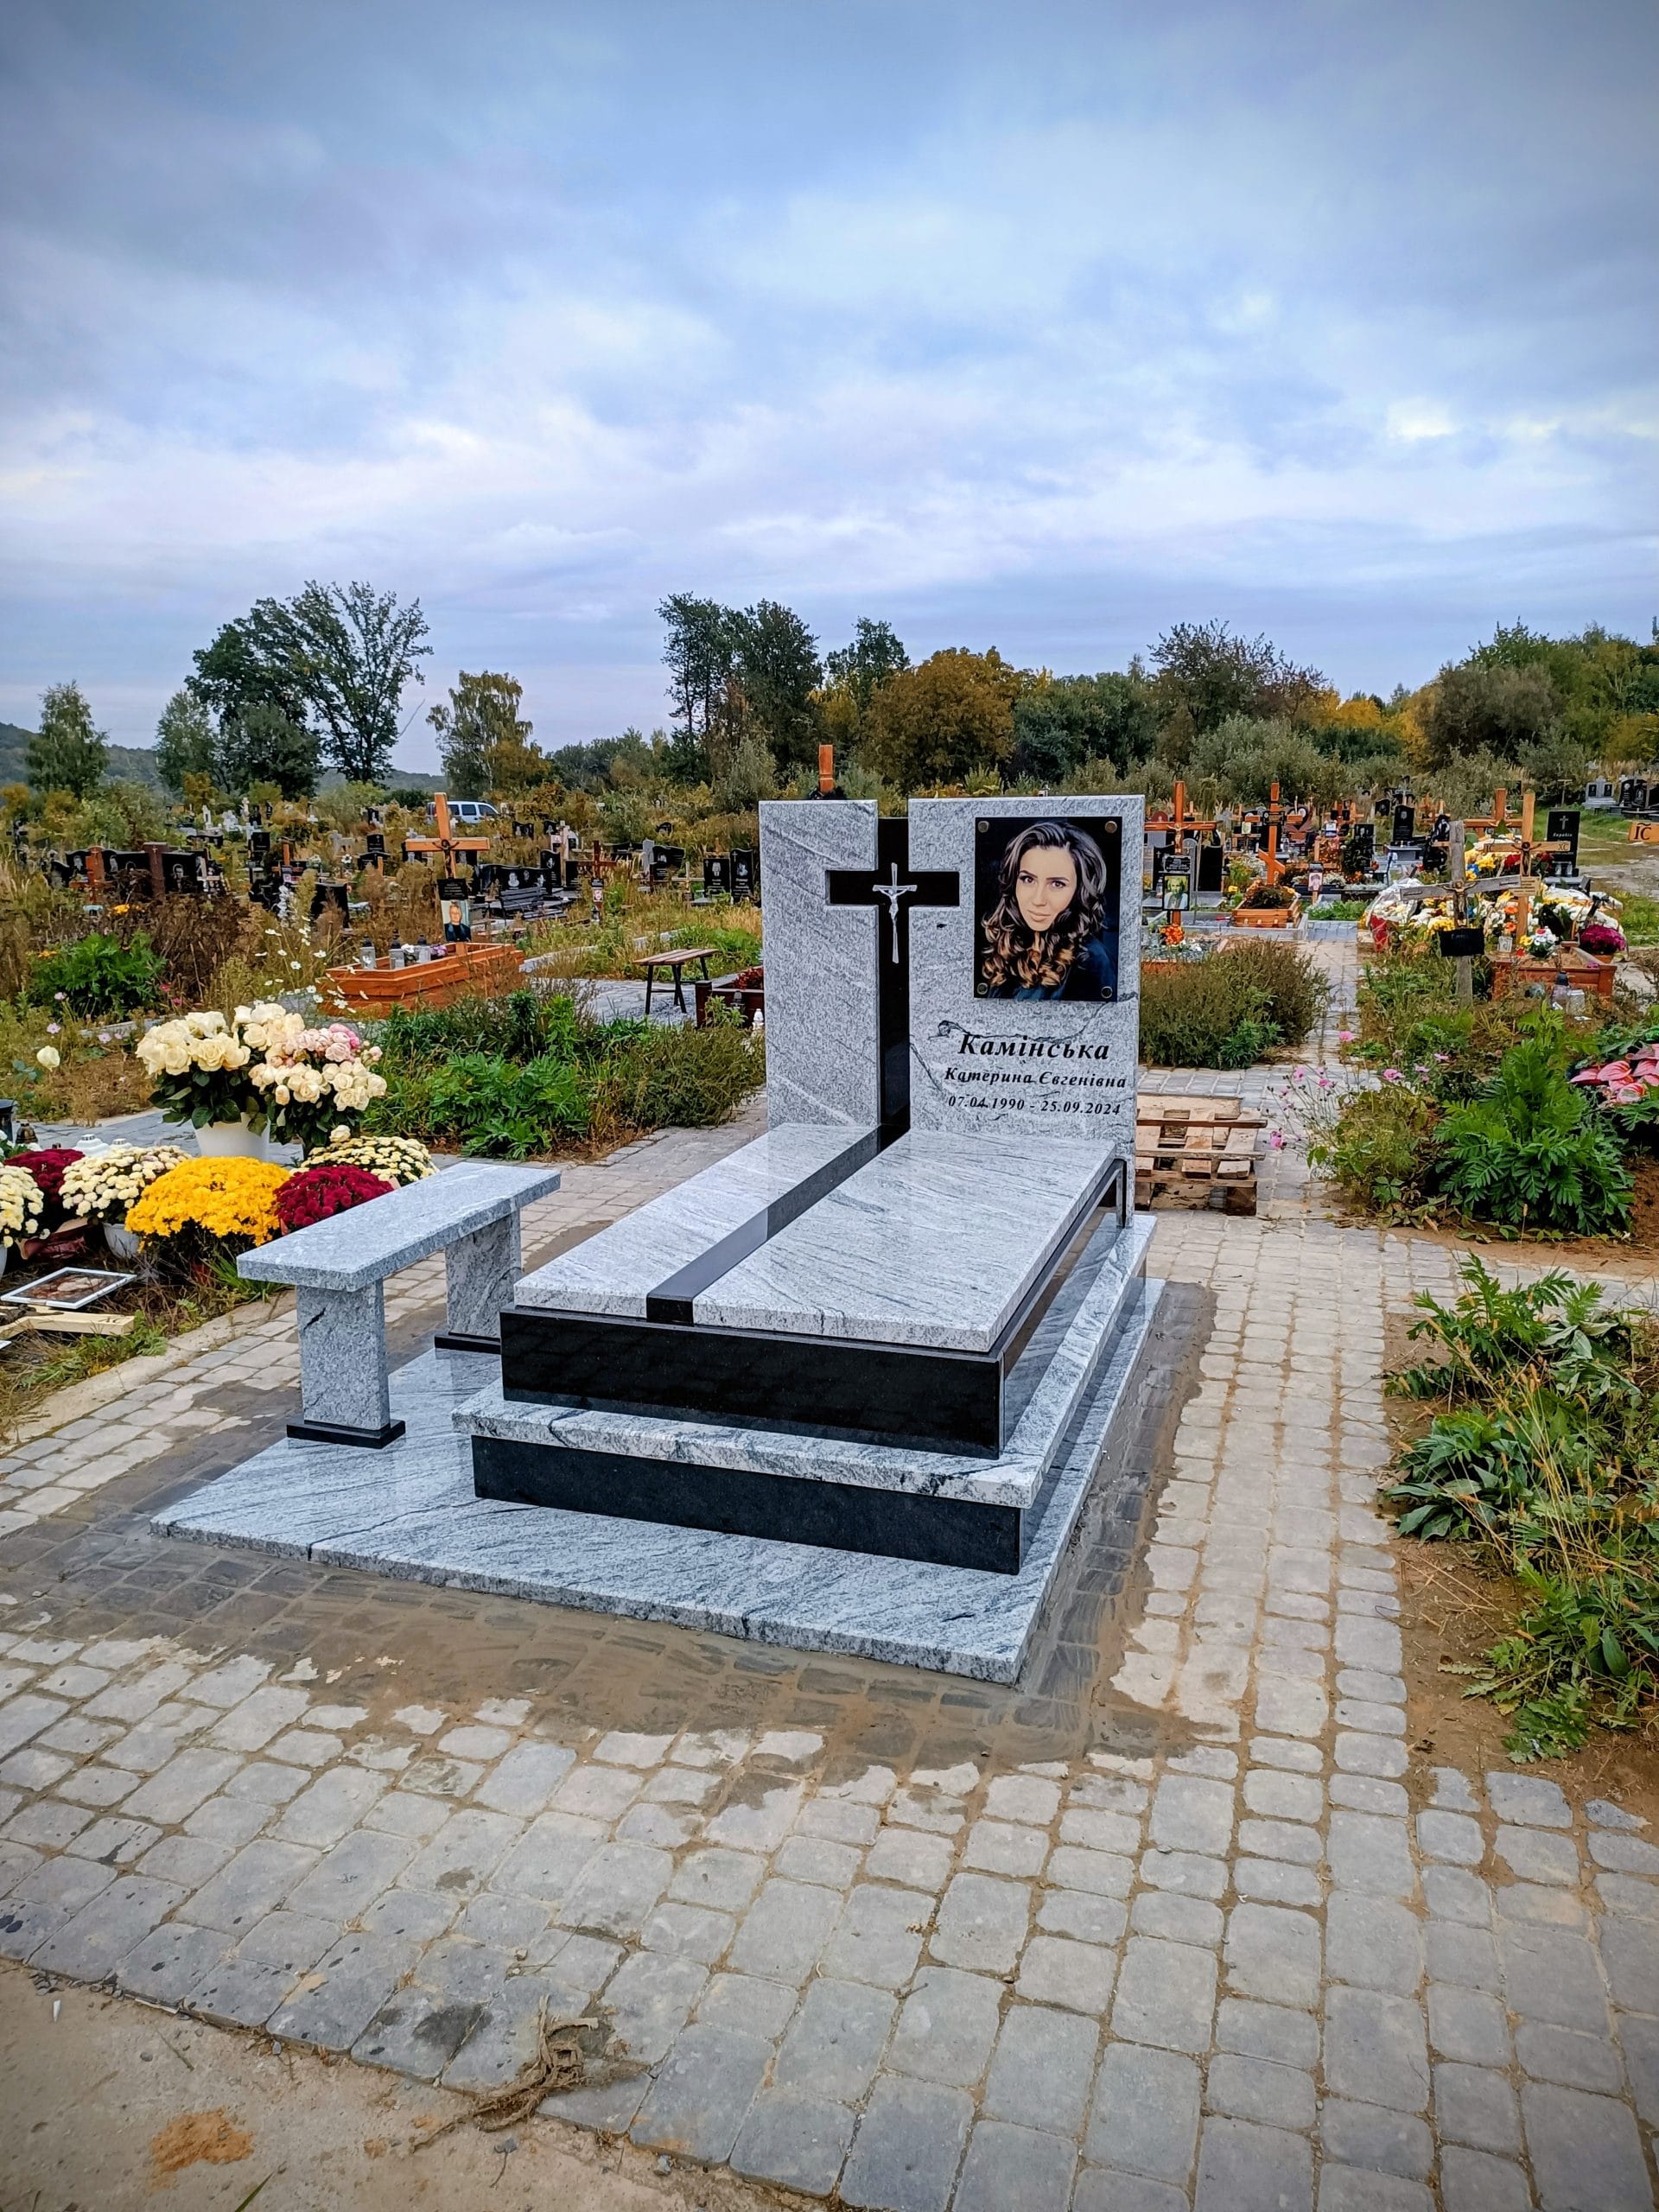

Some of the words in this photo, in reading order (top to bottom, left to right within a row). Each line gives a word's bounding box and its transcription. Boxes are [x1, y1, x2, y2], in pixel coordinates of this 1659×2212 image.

[957, 1033, 1110, 1060] Камінська
[944, 1067, 1032, 1086] Катерина
[1039, 1071, 1127, 1088] Євгенівна
[948, 1095, 1026, 1110] 07.04.1990
[1040, 1100, 1121, 1116] 25.09.2024
